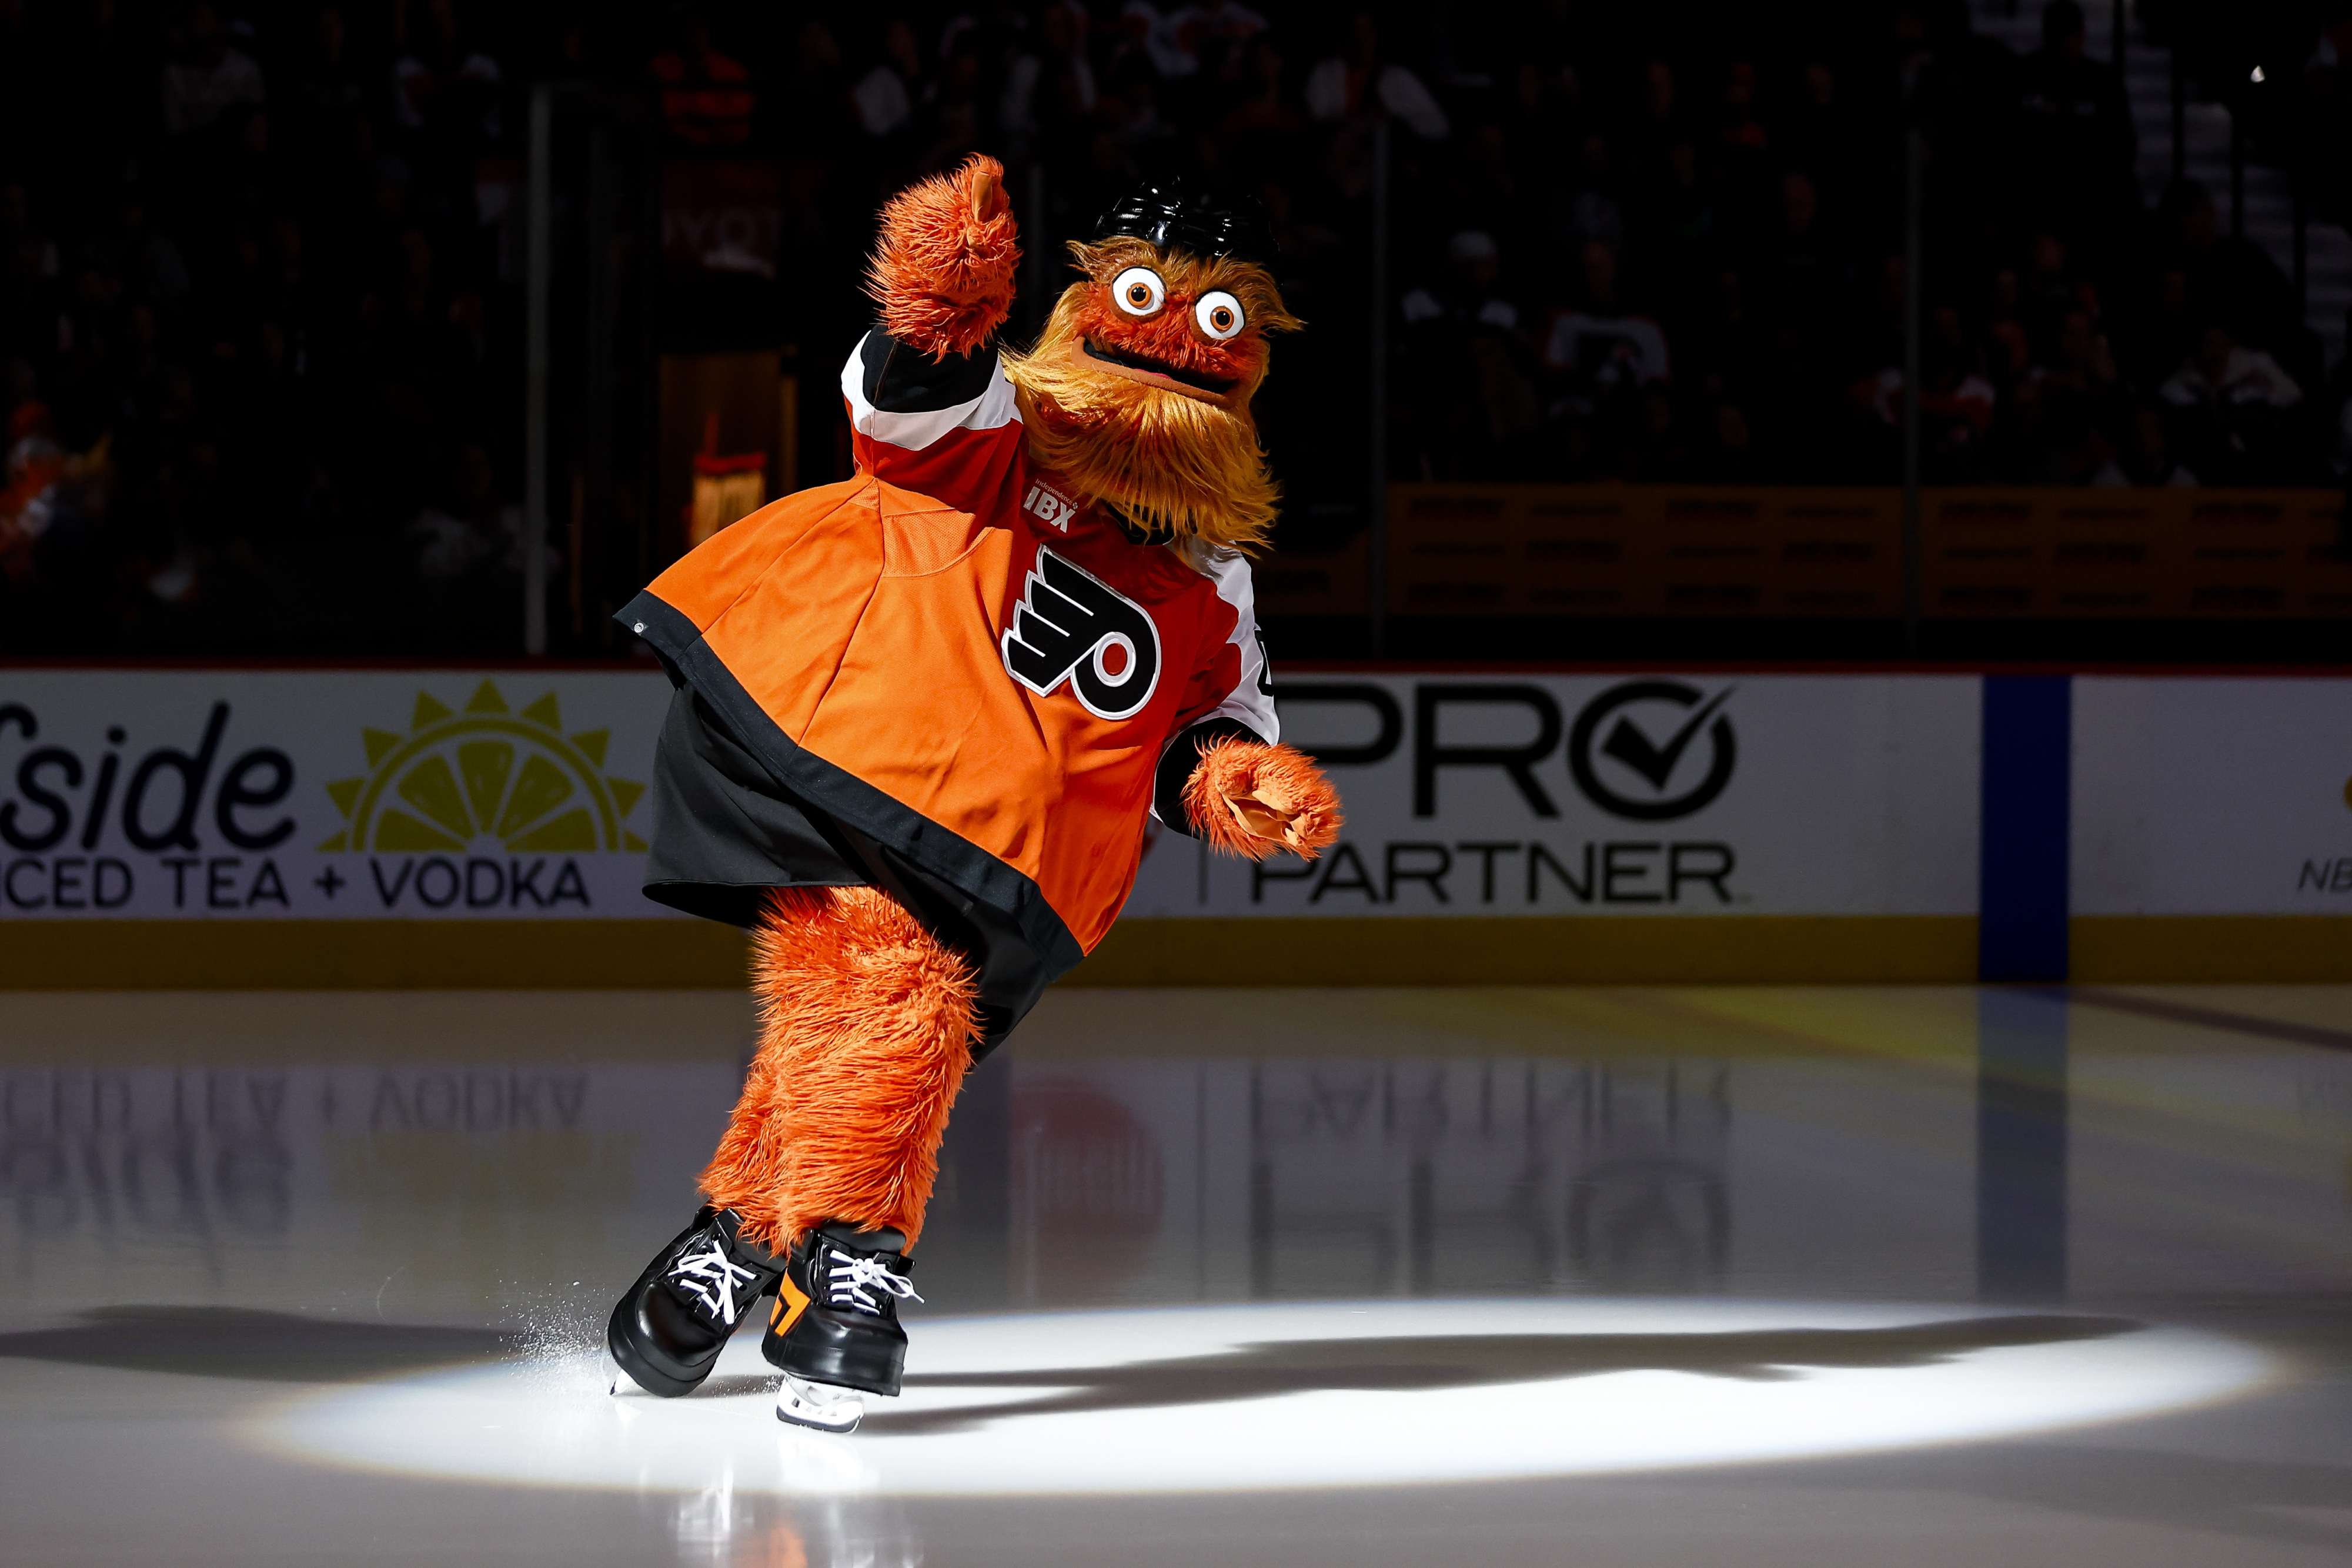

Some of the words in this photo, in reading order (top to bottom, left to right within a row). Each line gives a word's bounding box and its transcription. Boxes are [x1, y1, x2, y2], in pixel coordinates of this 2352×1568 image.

[1023, 486, 1076, 533] IBX
[1035, 478, 1073, 506] Independence
[160, 857, 290, 909] TEA
[369, 857, 591, 909] VODKA
[1252, 841, 1735, 905] PARTNER
